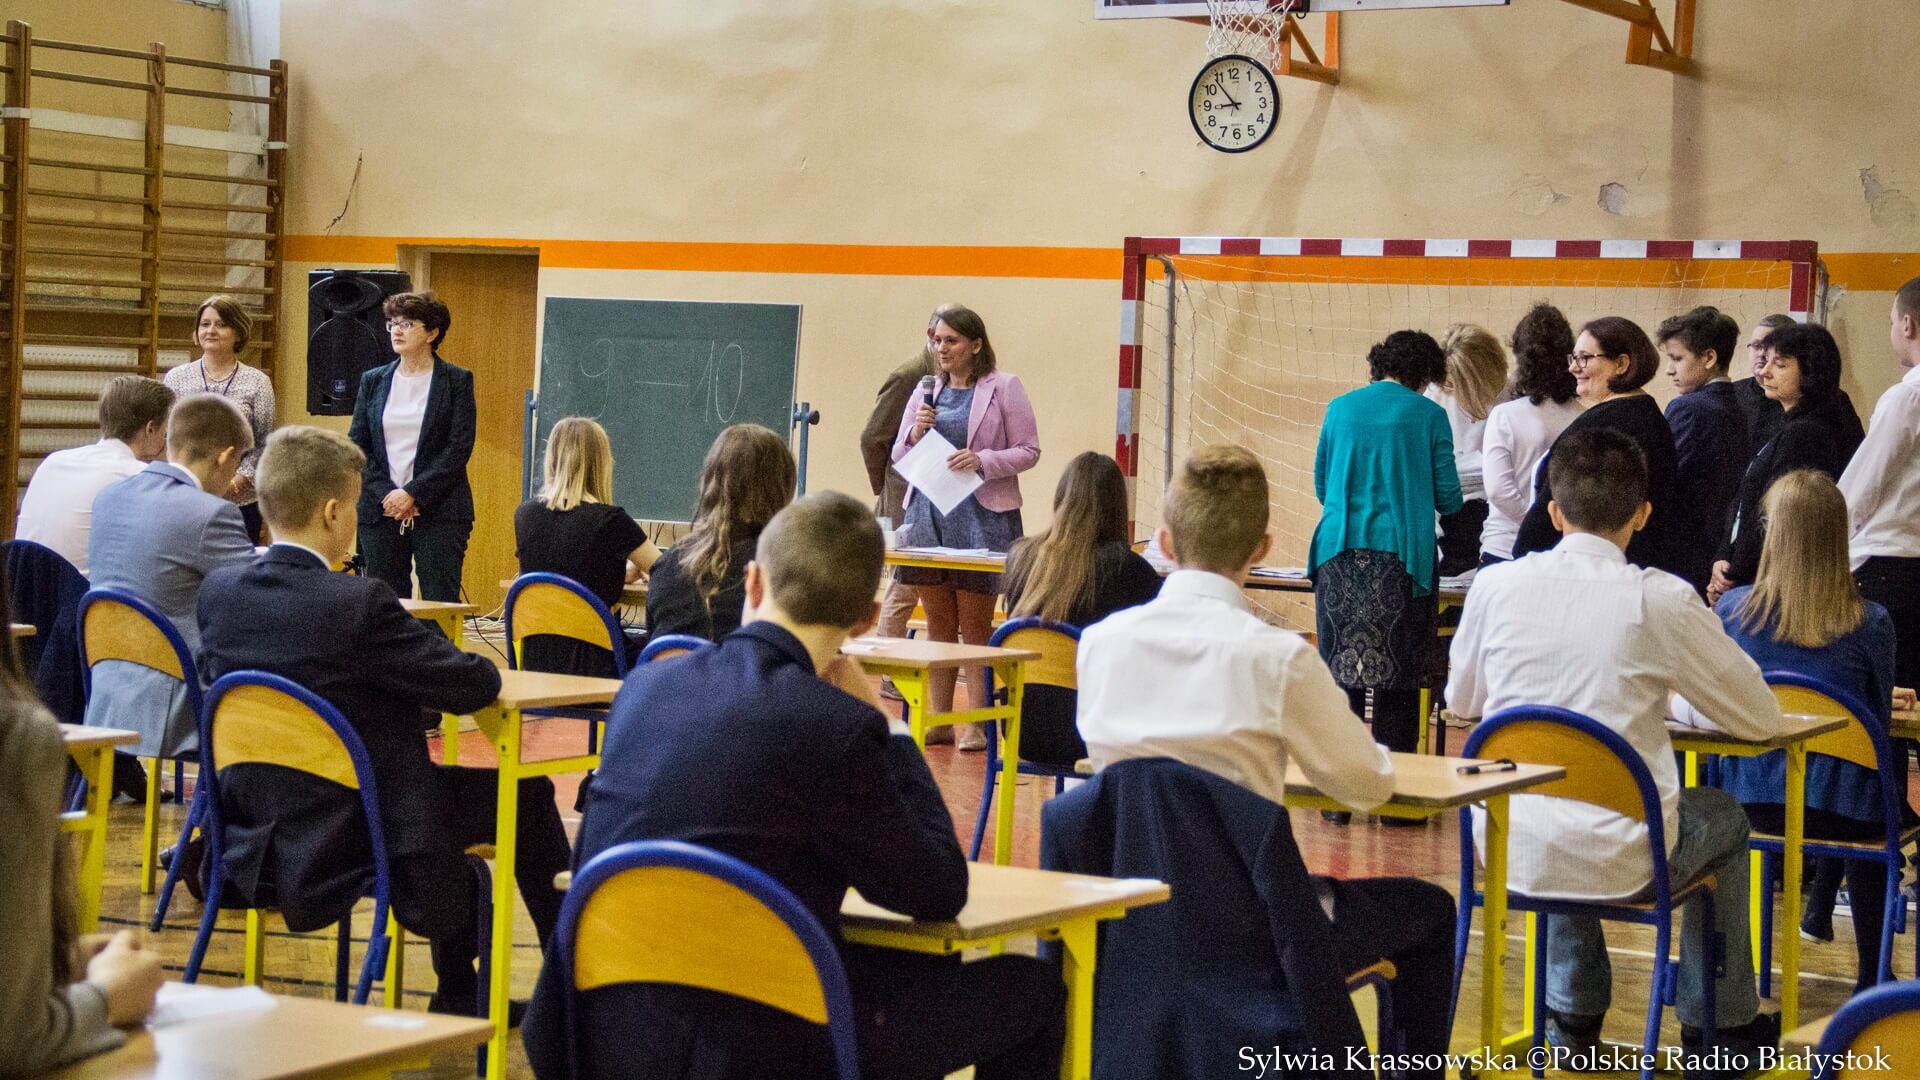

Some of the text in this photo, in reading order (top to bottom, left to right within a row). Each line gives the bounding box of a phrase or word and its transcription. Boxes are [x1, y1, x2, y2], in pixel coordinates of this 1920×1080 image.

[1214, 72, 1224, 83] 11
[1227, 67, 1240, 80] 12
[1205, 84, 1217, 96] 10
[1254, 81, 1263, 93] 2
[1203, 99, 1212, 111] 9
[1258, 96, 1267, 109] 3
[1208, 115, 1217, 127] 8
[1256, 112, 1265, 124] 4
[1219, 126, 1228, 138] 7
[1232, 127, 1241, 140] 6
[1247, 125, 1256, 137] 5
[580, 338, 615, 421] 9
[696, 340, 744, 423] 10
